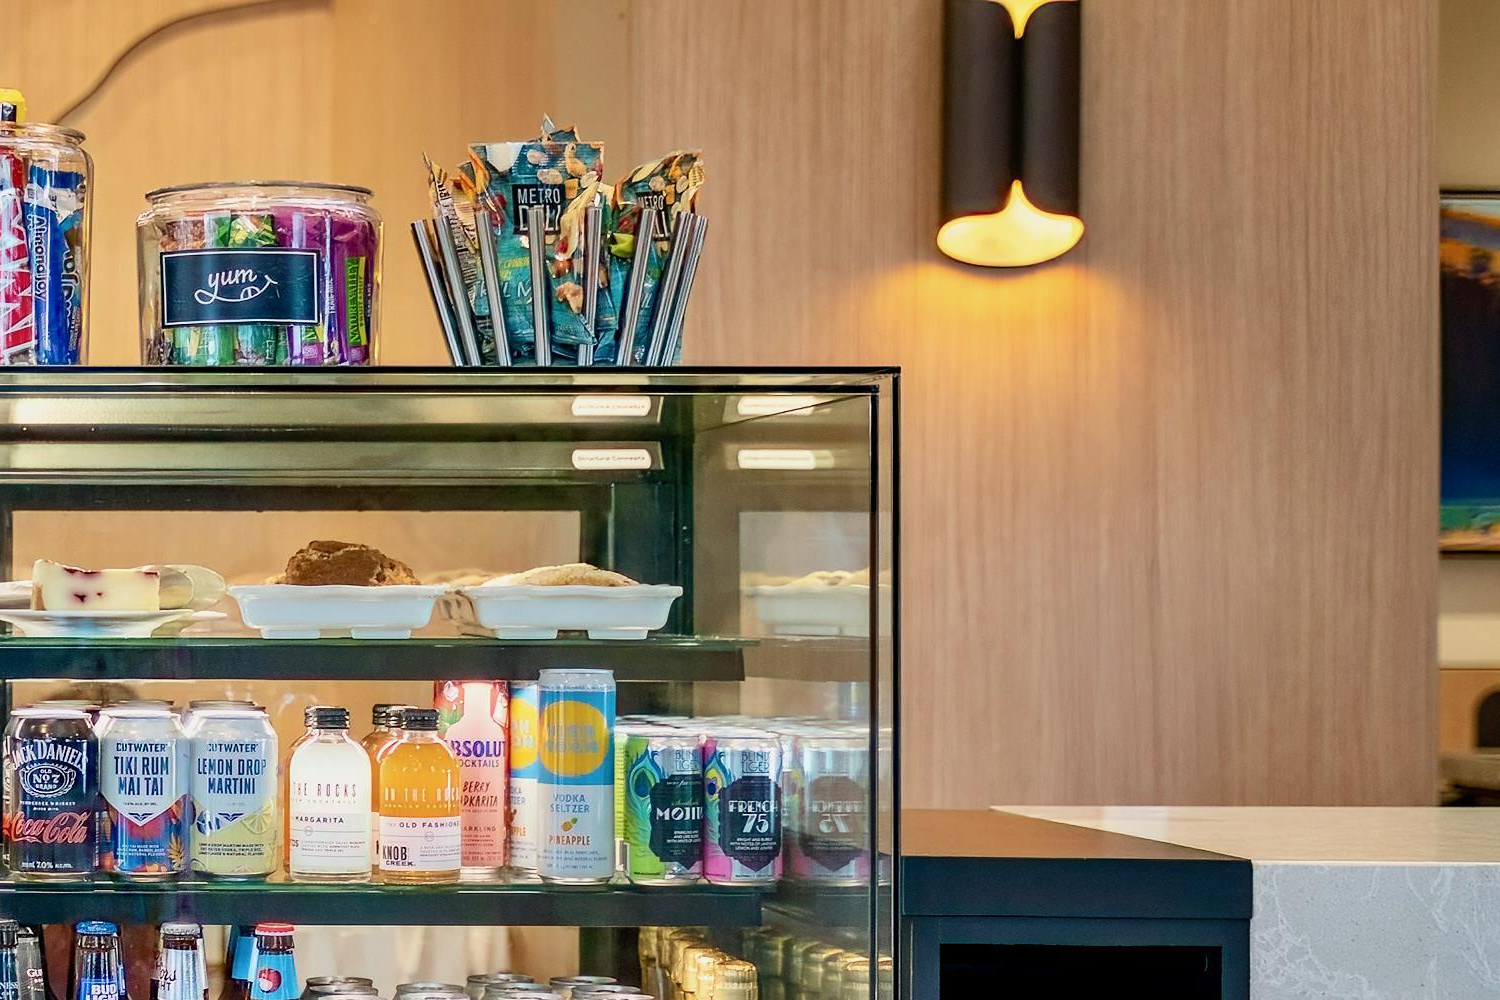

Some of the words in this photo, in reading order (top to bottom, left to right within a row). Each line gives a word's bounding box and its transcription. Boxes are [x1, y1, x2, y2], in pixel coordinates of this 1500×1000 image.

[517, 188, 561, 204] METRO
[347, 261, 359, 302] VALLEY
[347, 302, 359, 344] NATURE
[116, 743, 166, 752] CUTWATER
[12, 744, 35, 770] JACK
[114, 756, 137, 774] TIKI
[142, 757, 169, 774] RUM
[198, 758, 233, 775] LEMON
[238, 759, 266, 775] DROP
[50, 774, 59, 783] 7
[208, 778, 255, 794] MARTINI
[118, 777, 140, 796] MAI
[144, 777, 163, 796] TAI
[318, 784, 356, 797] ROCKS
[463, 781, 490, 793] BERRY
[554, 794, 586, 802] VODKA
[550, 803, 590, 813] SELTZER
[728, 800, 778, 813] FRENCH
[10, 811, 92, 843] Coca-Cola
[742, 813, 769, 833] 75
[549, 835, 590, 846] PINEAPPLE
[383, 846, 407, 860] KNOB
[92, 984, 116, 994] BUD
